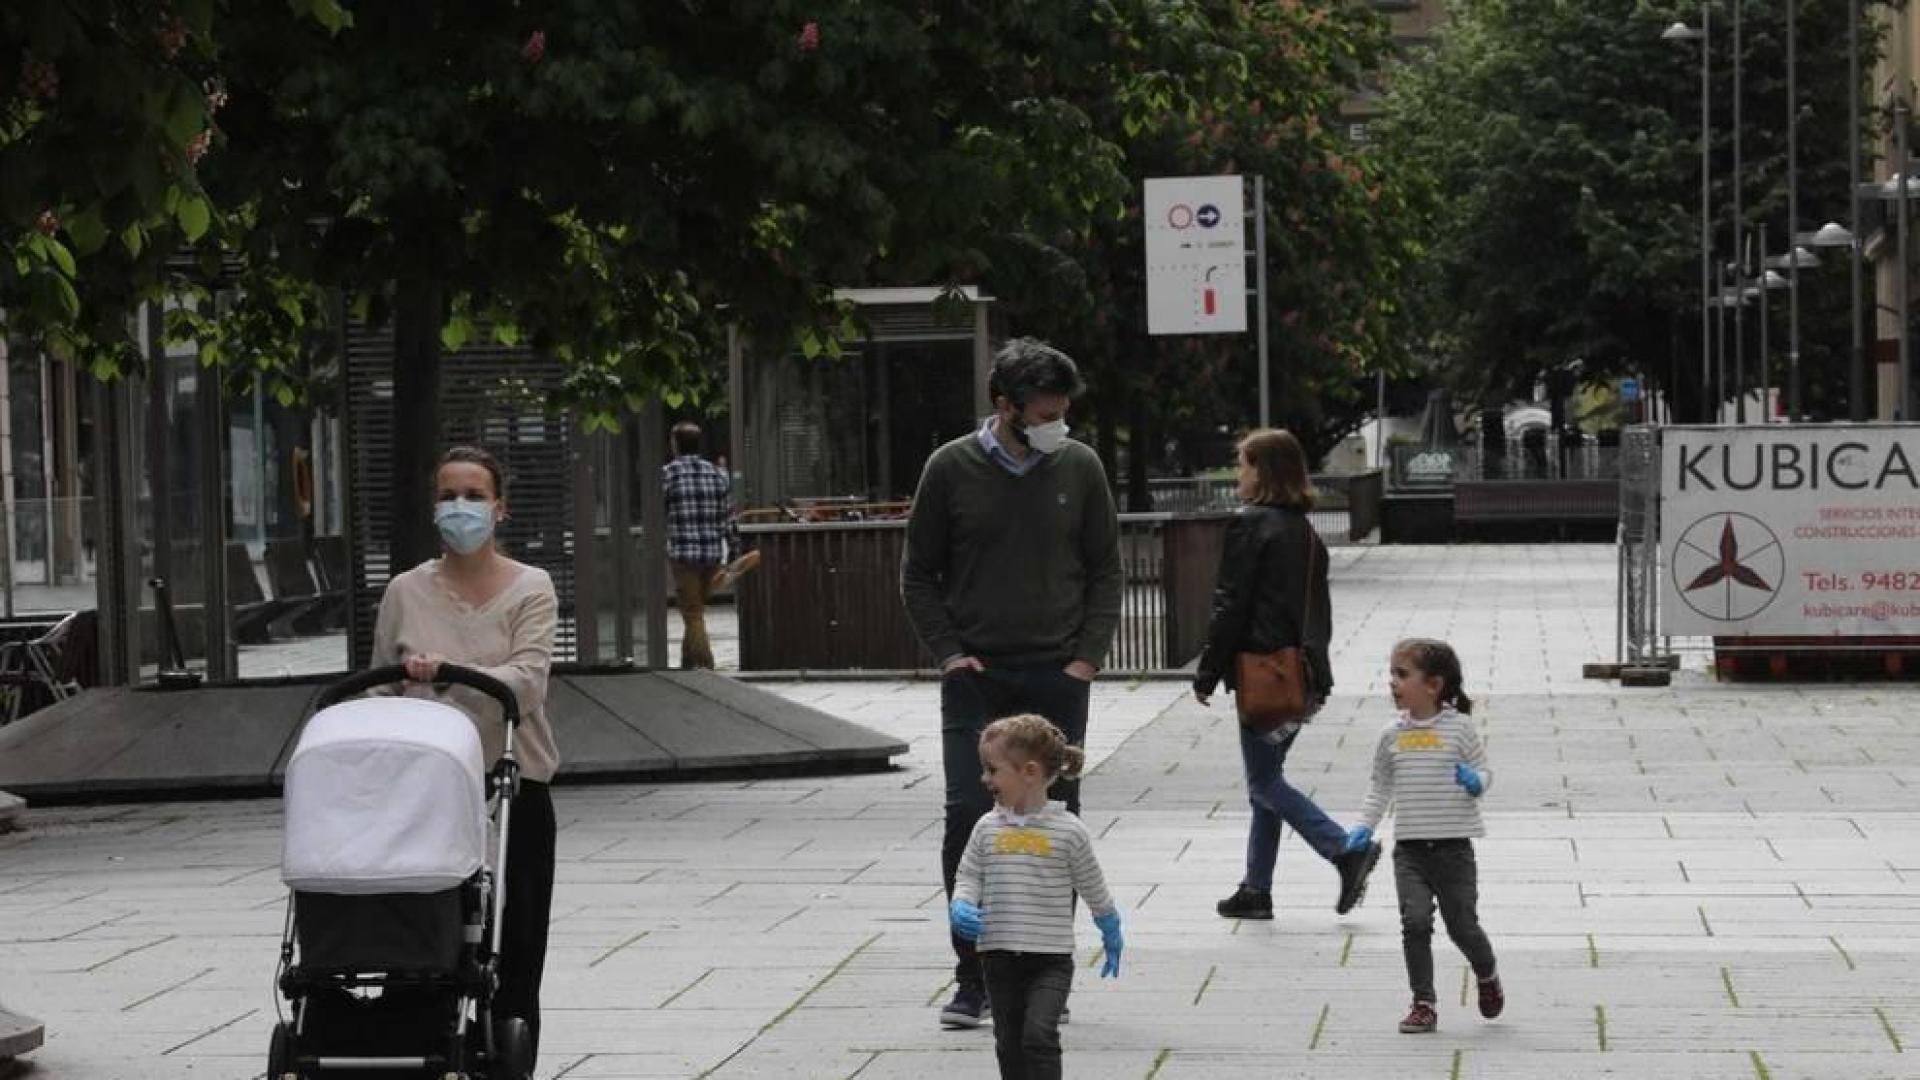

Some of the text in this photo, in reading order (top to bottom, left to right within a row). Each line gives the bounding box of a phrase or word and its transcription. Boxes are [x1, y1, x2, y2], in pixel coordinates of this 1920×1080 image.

[1679, 442, 1920, 491] KUBICA
[1819, 507, 1883, 520] SERVICIOS
[1802, 572, 1920, 591] Tels. 9482
